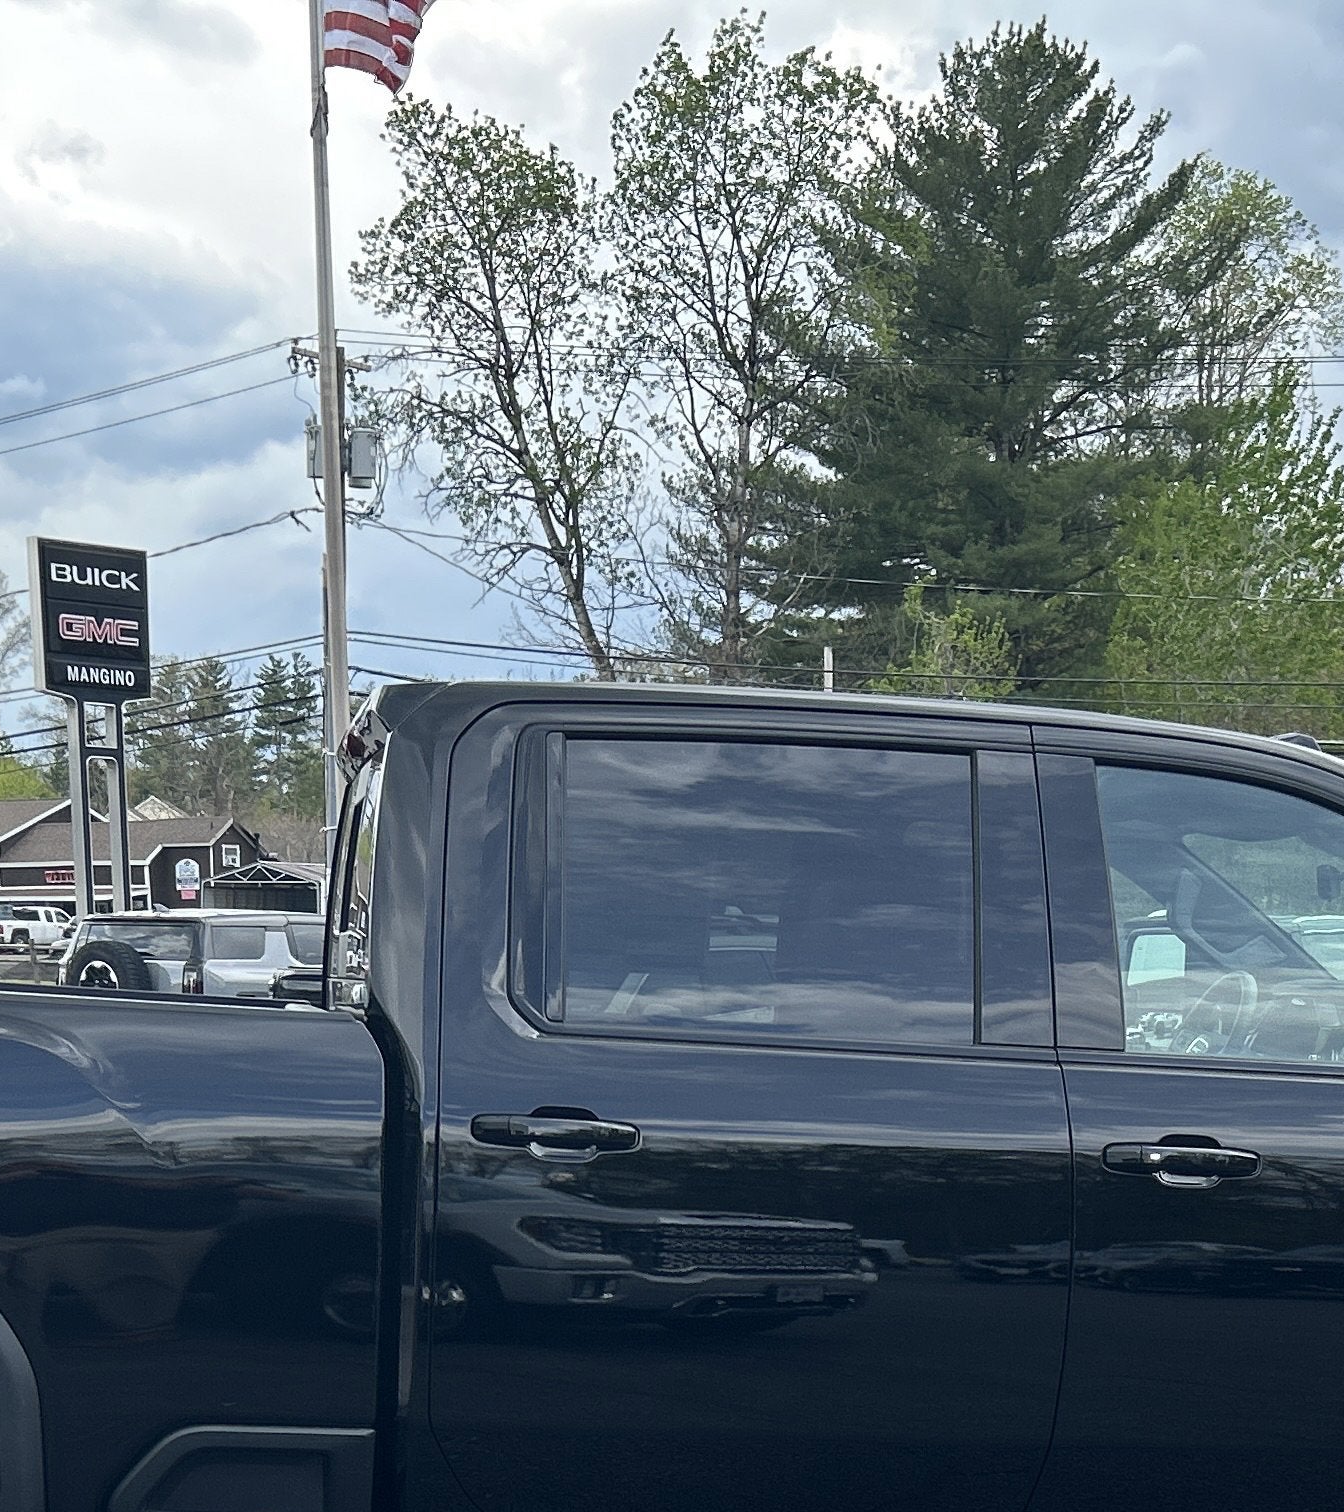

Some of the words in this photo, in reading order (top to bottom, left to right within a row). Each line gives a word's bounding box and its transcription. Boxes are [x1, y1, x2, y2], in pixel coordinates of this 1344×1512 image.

[50, 562, 141, 592] BUICK
[58, 613, 140, 647] GMC
[67, 664, 135, 687] MANGINO
